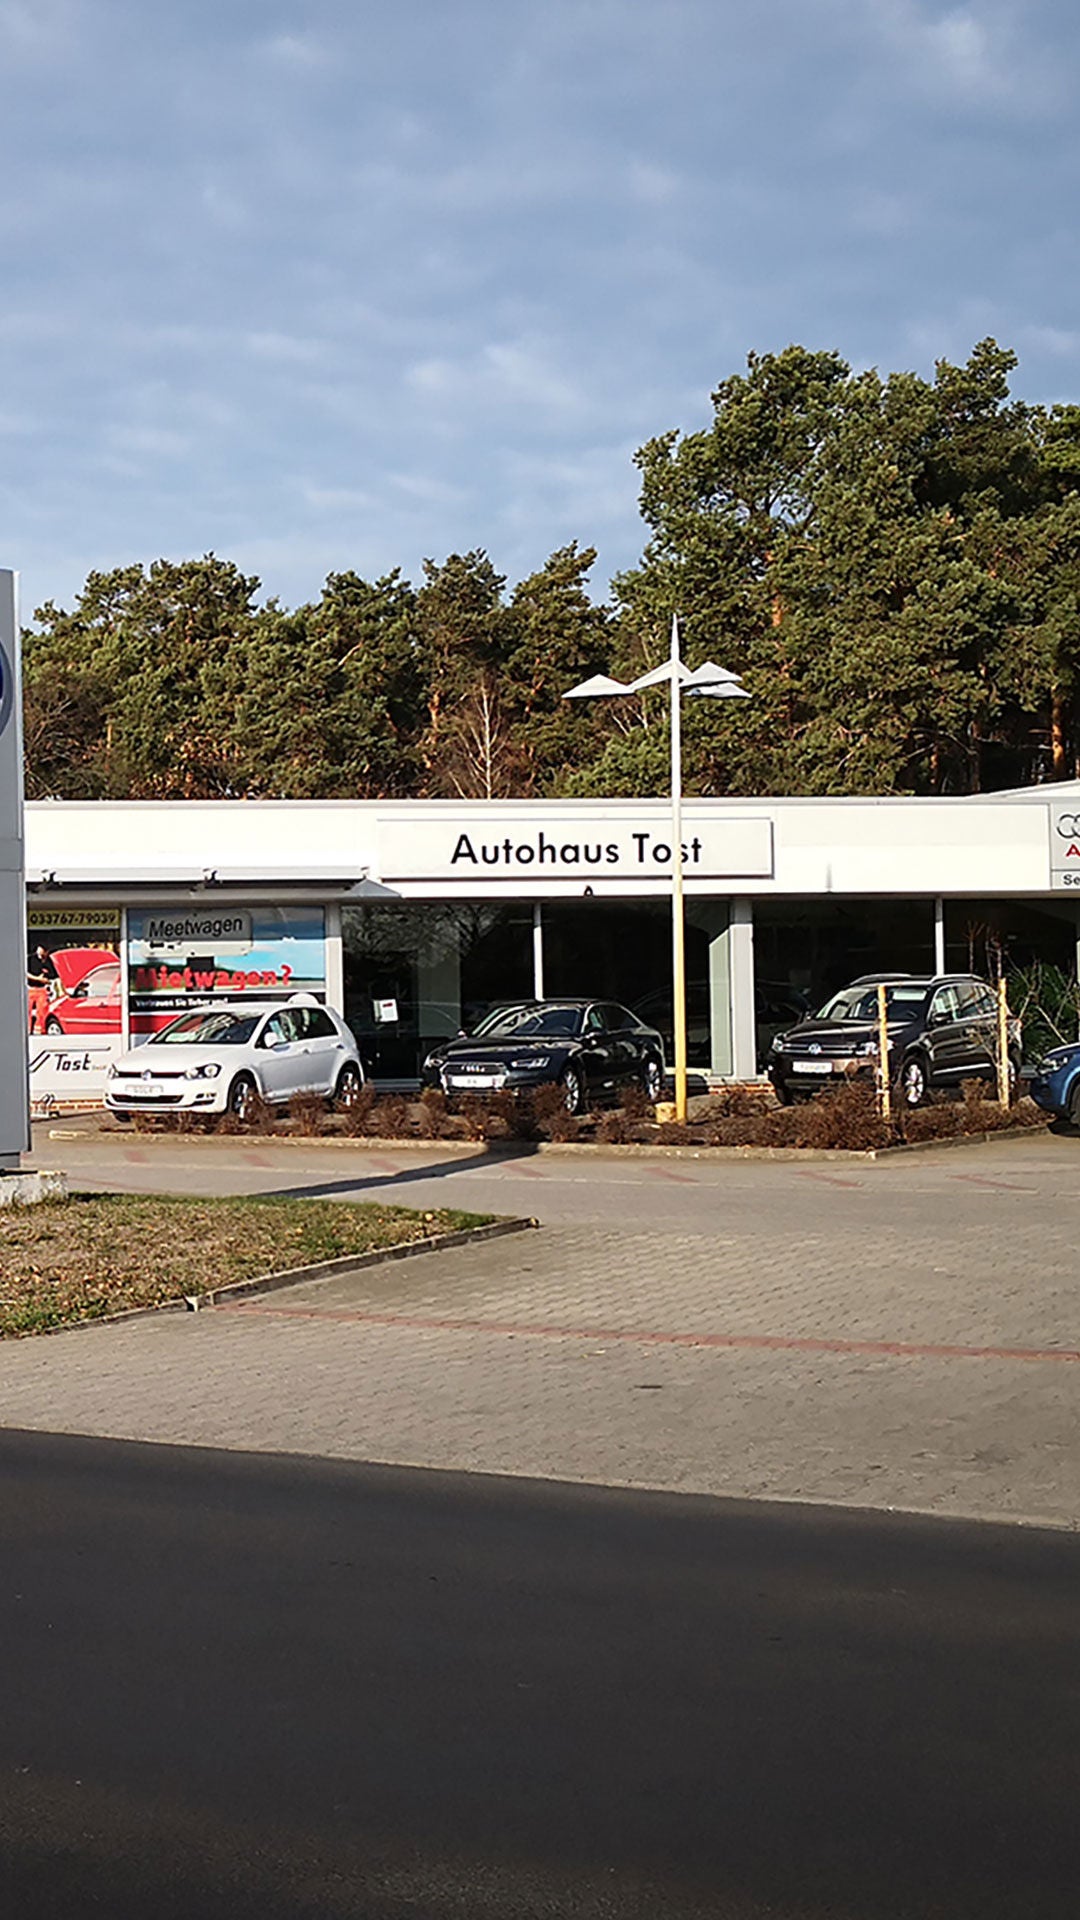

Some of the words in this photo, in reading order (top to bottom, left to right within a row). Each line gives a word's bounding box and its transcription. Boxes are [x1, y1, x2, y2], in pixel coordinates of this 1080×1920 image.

[451, 832, 619, 865] Autohaus
[632, 832, 703, 865] Tost
[30, 912, 116, 925] 033767-79039
[149, 918, 243, 938] Meetwagen
[54, 1053, 92, 1071] Tost
